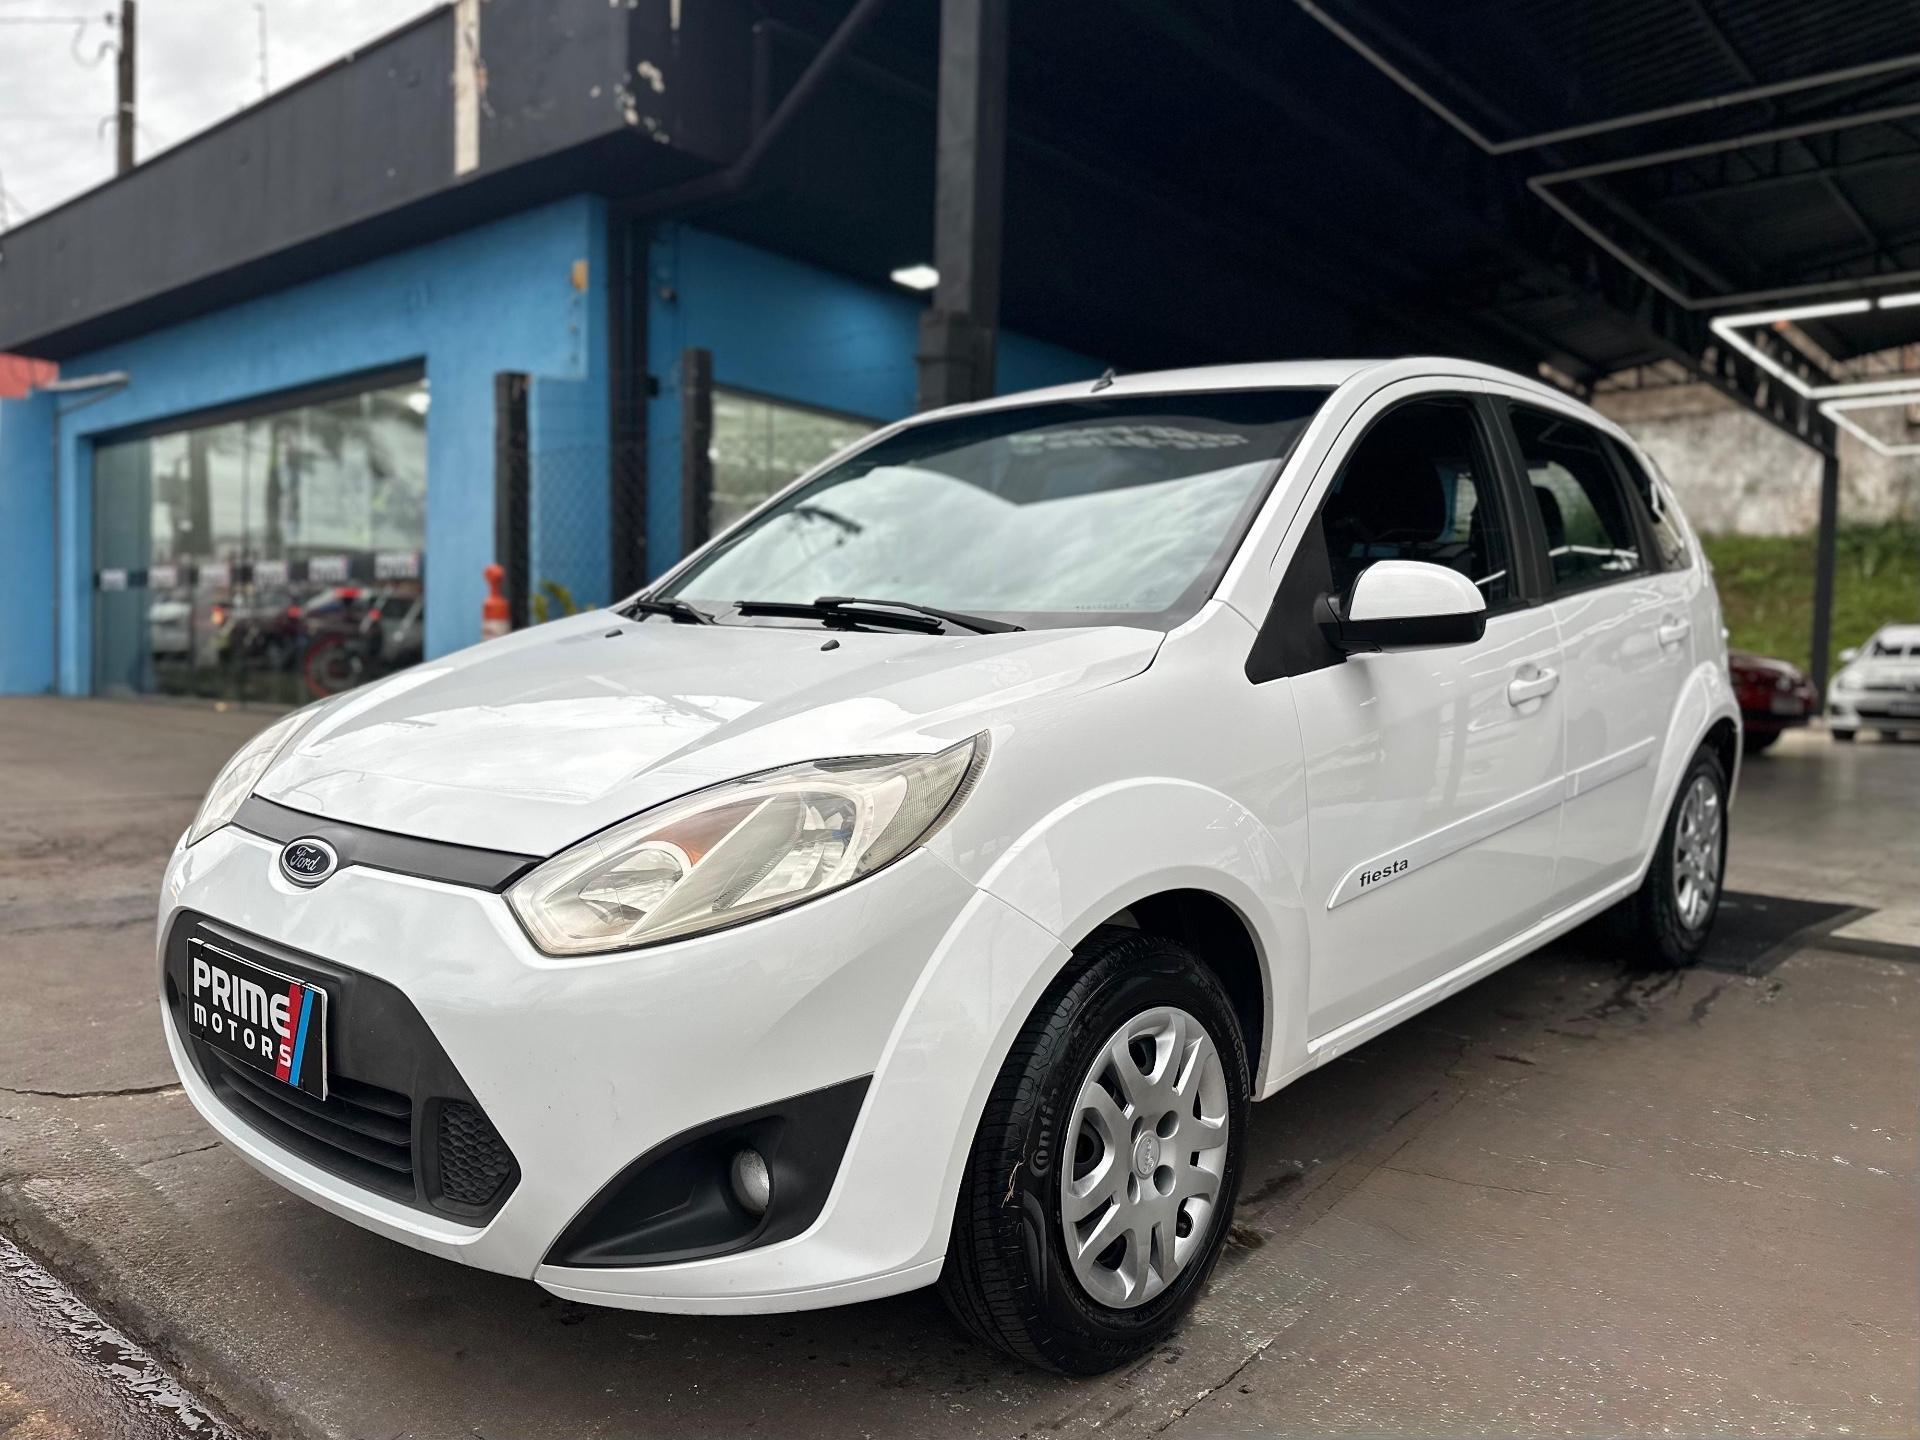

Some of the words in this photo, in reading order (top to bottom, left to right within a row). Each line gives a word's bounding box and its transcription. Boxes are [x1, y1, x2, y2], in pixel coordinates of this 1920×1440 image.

[290, 845, 321, 871] Ford
[1359, 859, 1408, 887] fiesta
[193, 957, 291, 1039] PRIME
[193, 1002, 292, 1068] MOTORS
